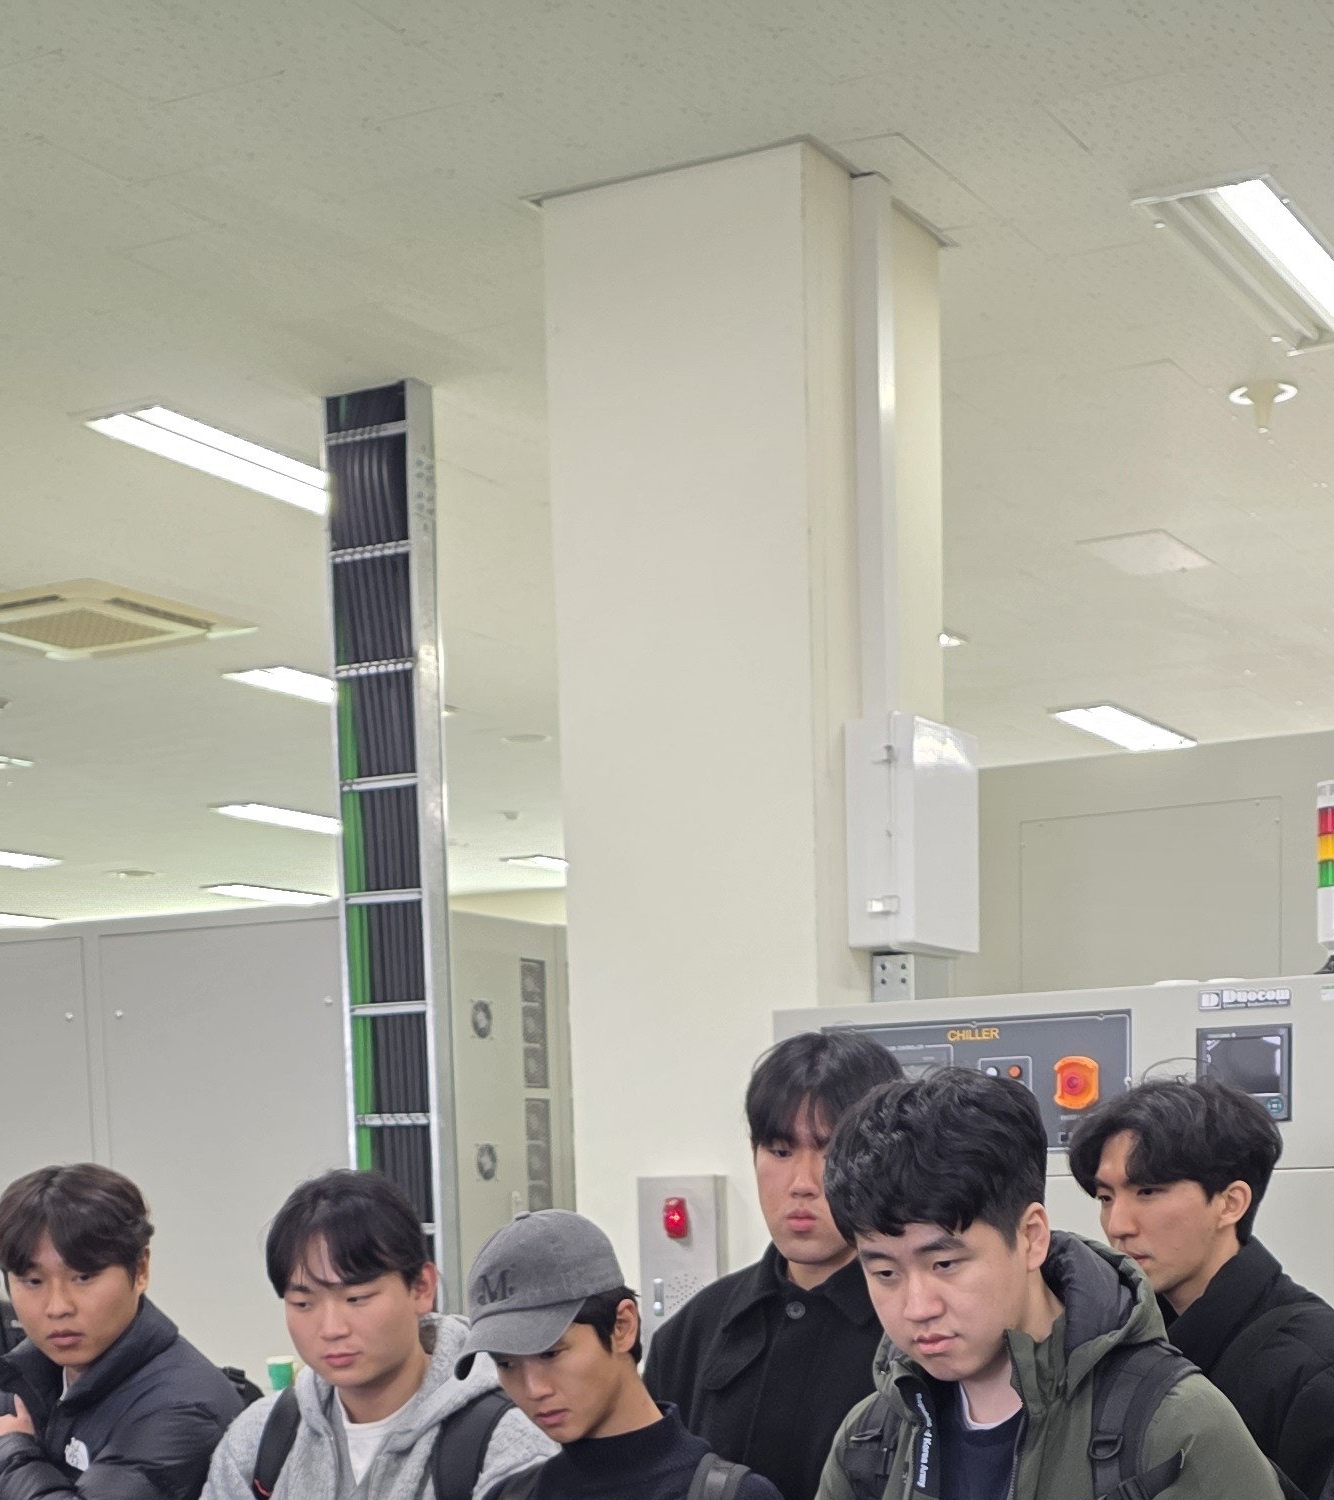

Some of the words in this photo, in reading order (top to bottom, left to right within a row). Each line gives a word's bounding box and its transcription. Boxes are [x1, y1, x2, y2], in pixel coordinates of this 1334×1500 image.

[1223, 988, 1290, 1003] Duocom
[947, 1027, 999, 1042] CHILLER
[921, 1438, 932, 1463] Korea
[917, 1464, 928, 1487] Army
